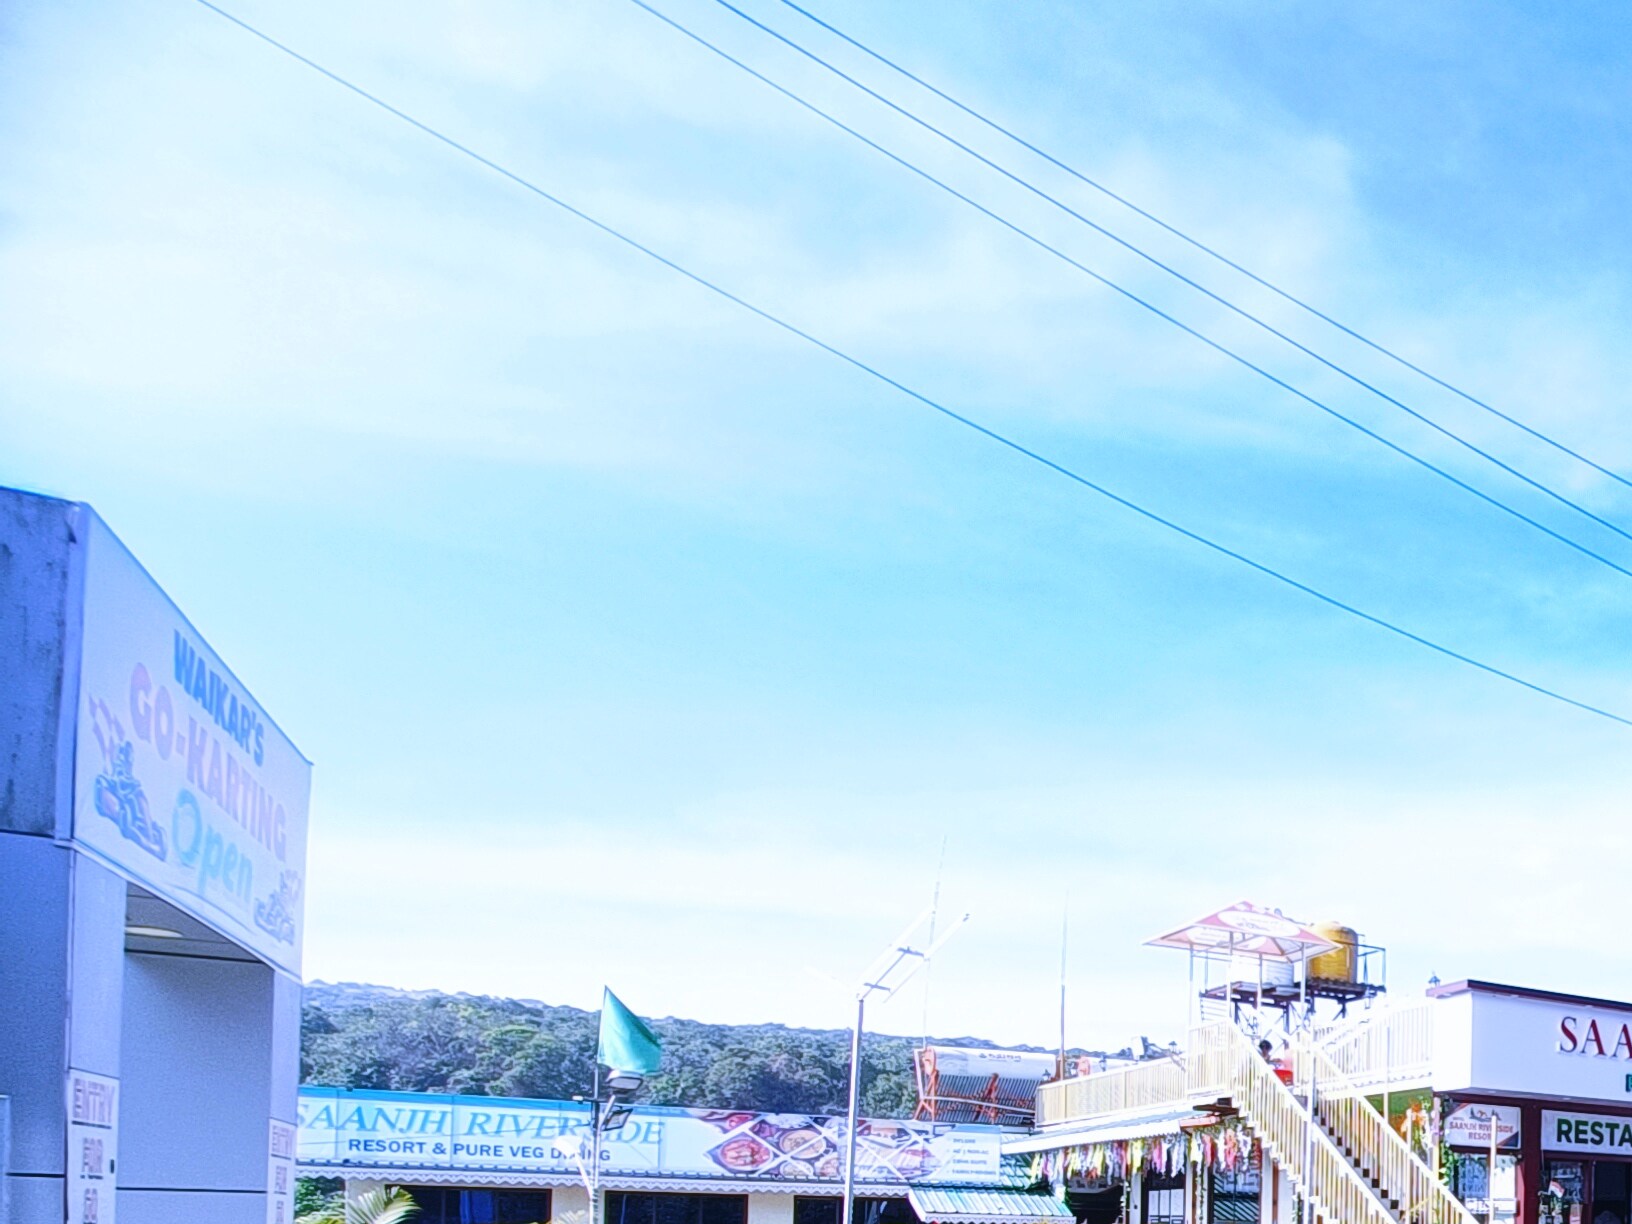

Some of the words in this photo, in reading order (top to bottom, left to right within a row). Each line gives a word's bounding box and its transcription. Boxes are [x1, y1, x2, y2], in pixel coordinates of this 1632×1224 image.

[174, 628, 265, 769] WAIKAR'S
[130, 662, 287, 864] GO-KARTING
[172, 787, 253, 907] Open
[73, 1078, 115, 1123] ENTRY
[297, 1103, 453, 1135] SAANJH
[464, 1111, 665, 1145] RIVERDE
[349, 1139, 427, 1154] RESORT
[432, 1142, 447, 1155] &
[453, 1143, 503, 1157] PURE
[509, 1146, 544, 1159] VEG
